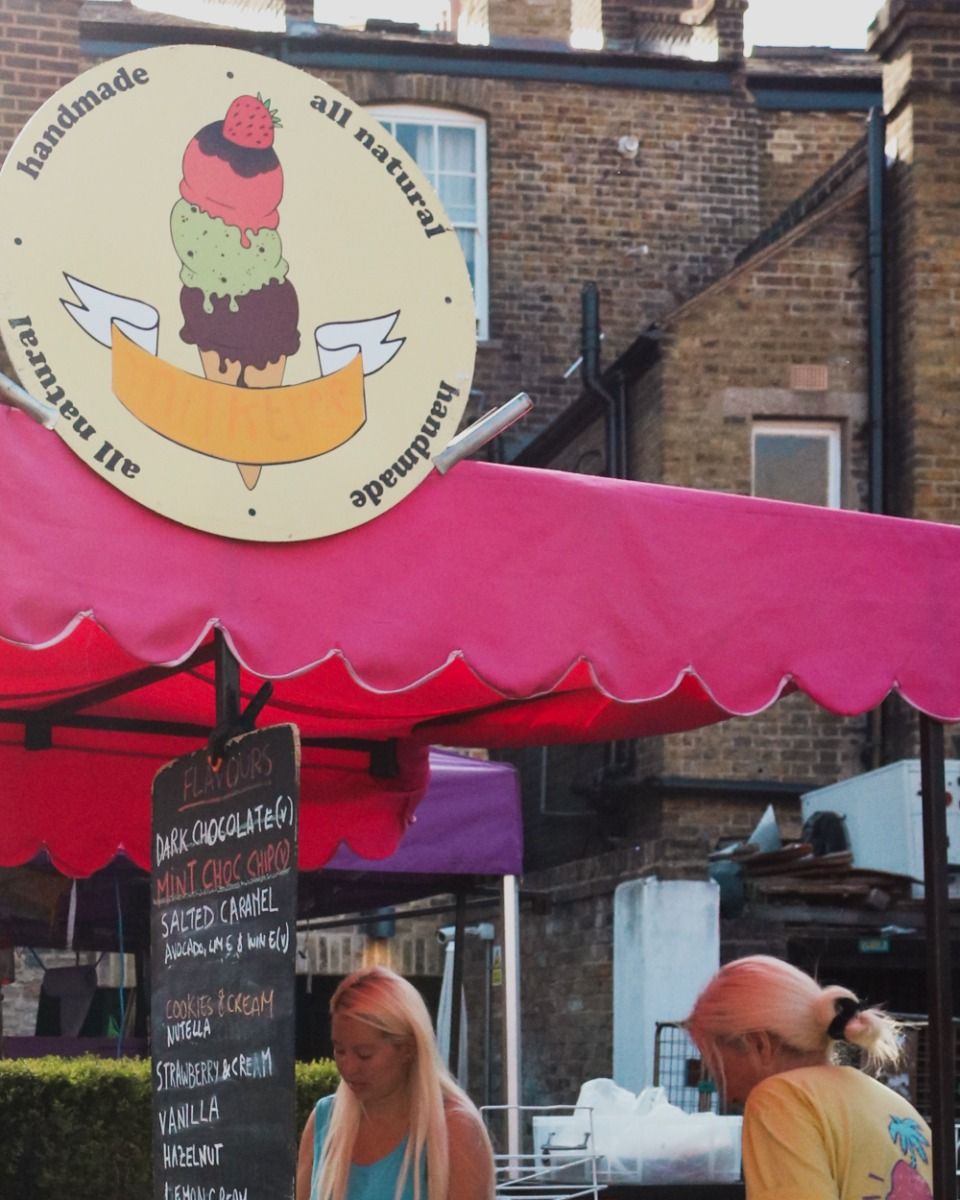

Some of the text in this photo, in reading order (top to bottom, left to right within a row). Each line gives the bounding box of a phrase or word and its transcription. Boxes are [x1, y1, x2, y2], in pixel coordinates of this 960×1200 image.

[16, 64, 150, 181] handmade
[310, 92, 446, 240] all natural
[8, 315, 141, 480] natural all
[349, 380, 460, 511] handmade
[184, 743, 273, 802] FLAVOURS
[156, 827, 189, 867] DARK
[156, 859, 198, 904] MINT
[202, 853, 241, 889] CHOC
[161, 886, 279, 939] SALTED CARAMEL
[166, 993, 214, 1020] COOKIES
[227, 989, 275, 1019] CREAM
[167, 1017, 212, 1048] NUTELLA
[156, 1059, 220, 1092] STRAWBERRY
[231, 1047, 273, 1078] CREAM
[158, 1095, 220, 1136] VANILLA
[163, 1143, 224, 1169] HAZELNUT
